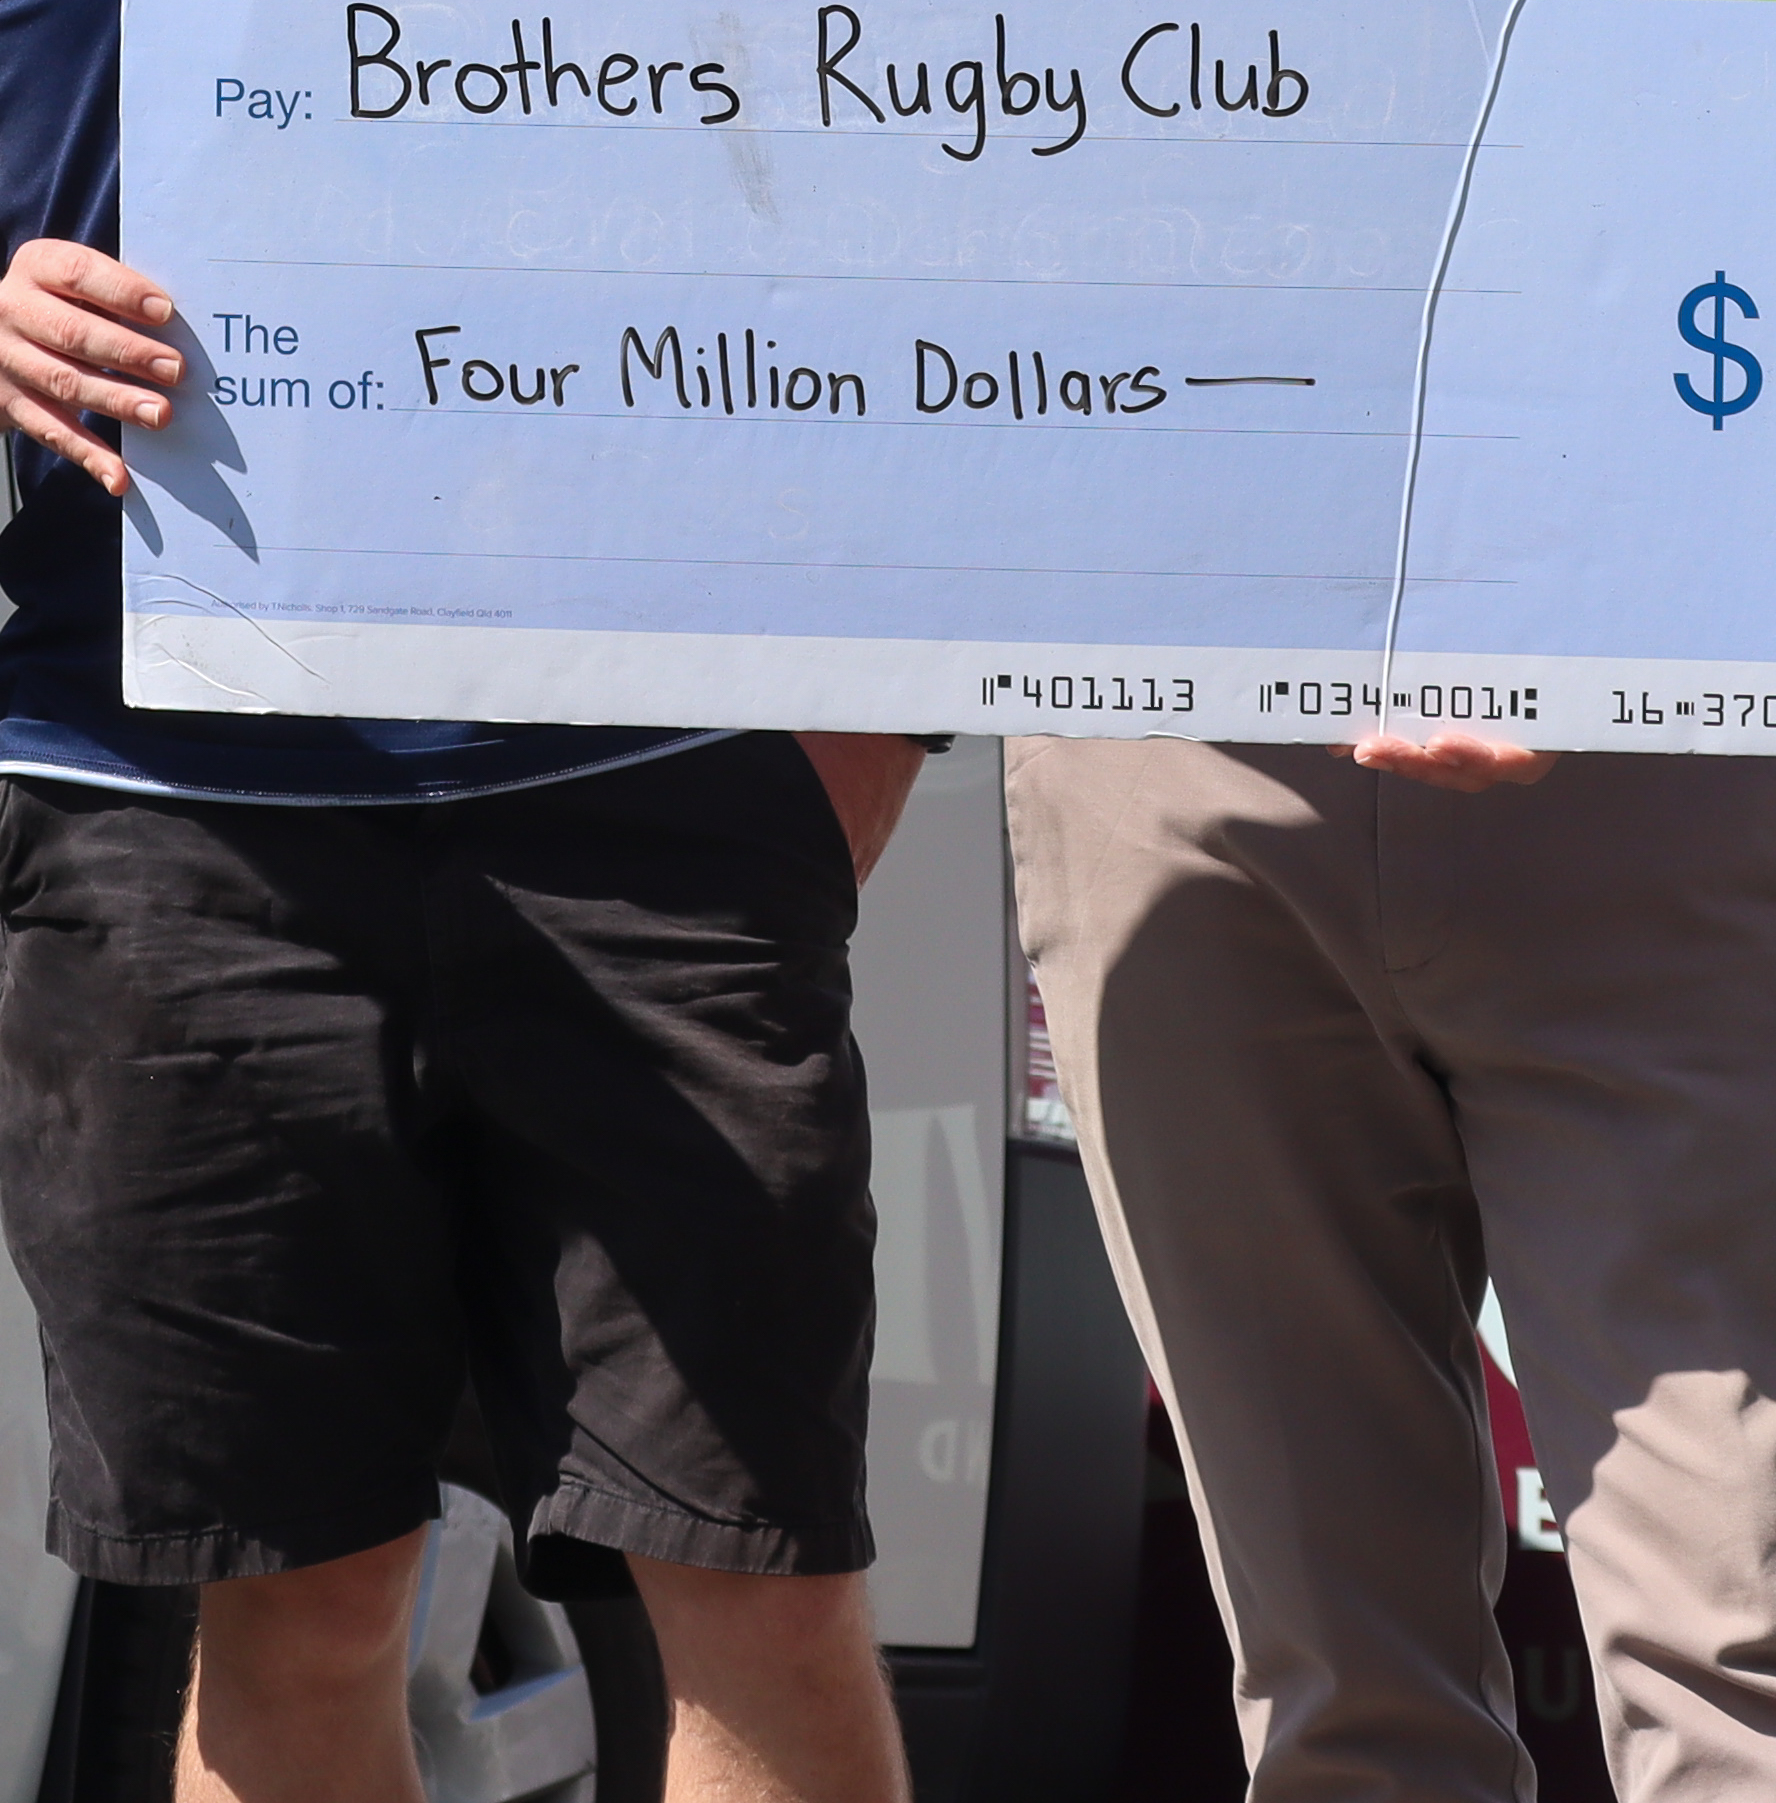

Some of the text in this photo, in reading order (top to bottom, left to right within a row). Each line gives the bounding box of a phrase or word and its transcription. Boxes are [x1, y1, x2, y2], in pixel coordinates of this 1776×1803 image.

[214, 77, 313, 124] Pay:
[346, 3, 1310, 162] Brothers Rugby Club
[212, 313, 300, 356] The
[212, 368, 386, 412] sum of:
[415, 325, 1169, 417] Four Million Dollars
[211, 599, 257, 612] Auorised
[315, 604, 339, 614] Shop
[367, 605, 409, 617] Sandgate
[437, 608, 474, 619] Clayfield
[476, 609, 493, 618] Qld
